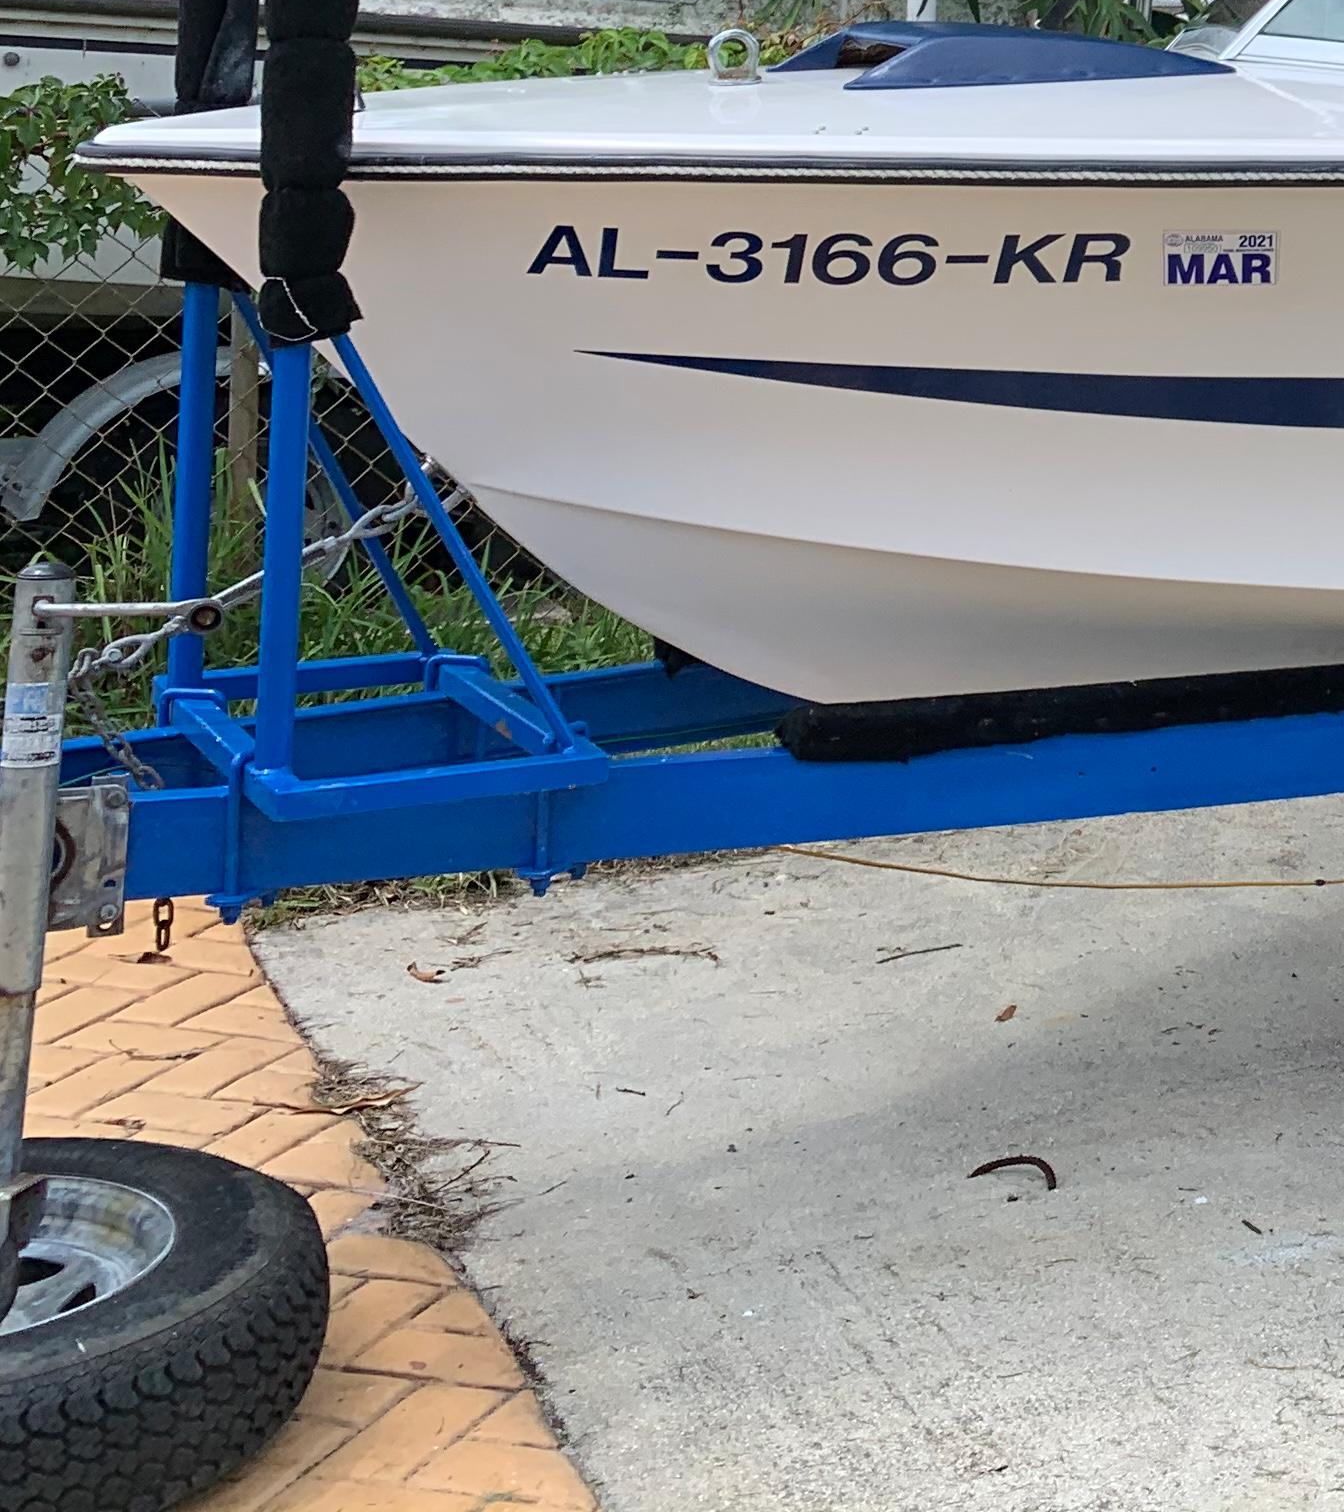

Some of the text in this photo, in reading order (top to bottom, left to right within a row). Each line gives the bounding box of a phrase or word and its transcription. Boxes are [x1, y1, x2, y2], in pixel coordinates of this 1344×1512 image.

[526, 224, 1132, 287] AL-3166-KR
[1239, 234, 1274, 248] 2021
[1167, 253, 1272, 285] MAR
